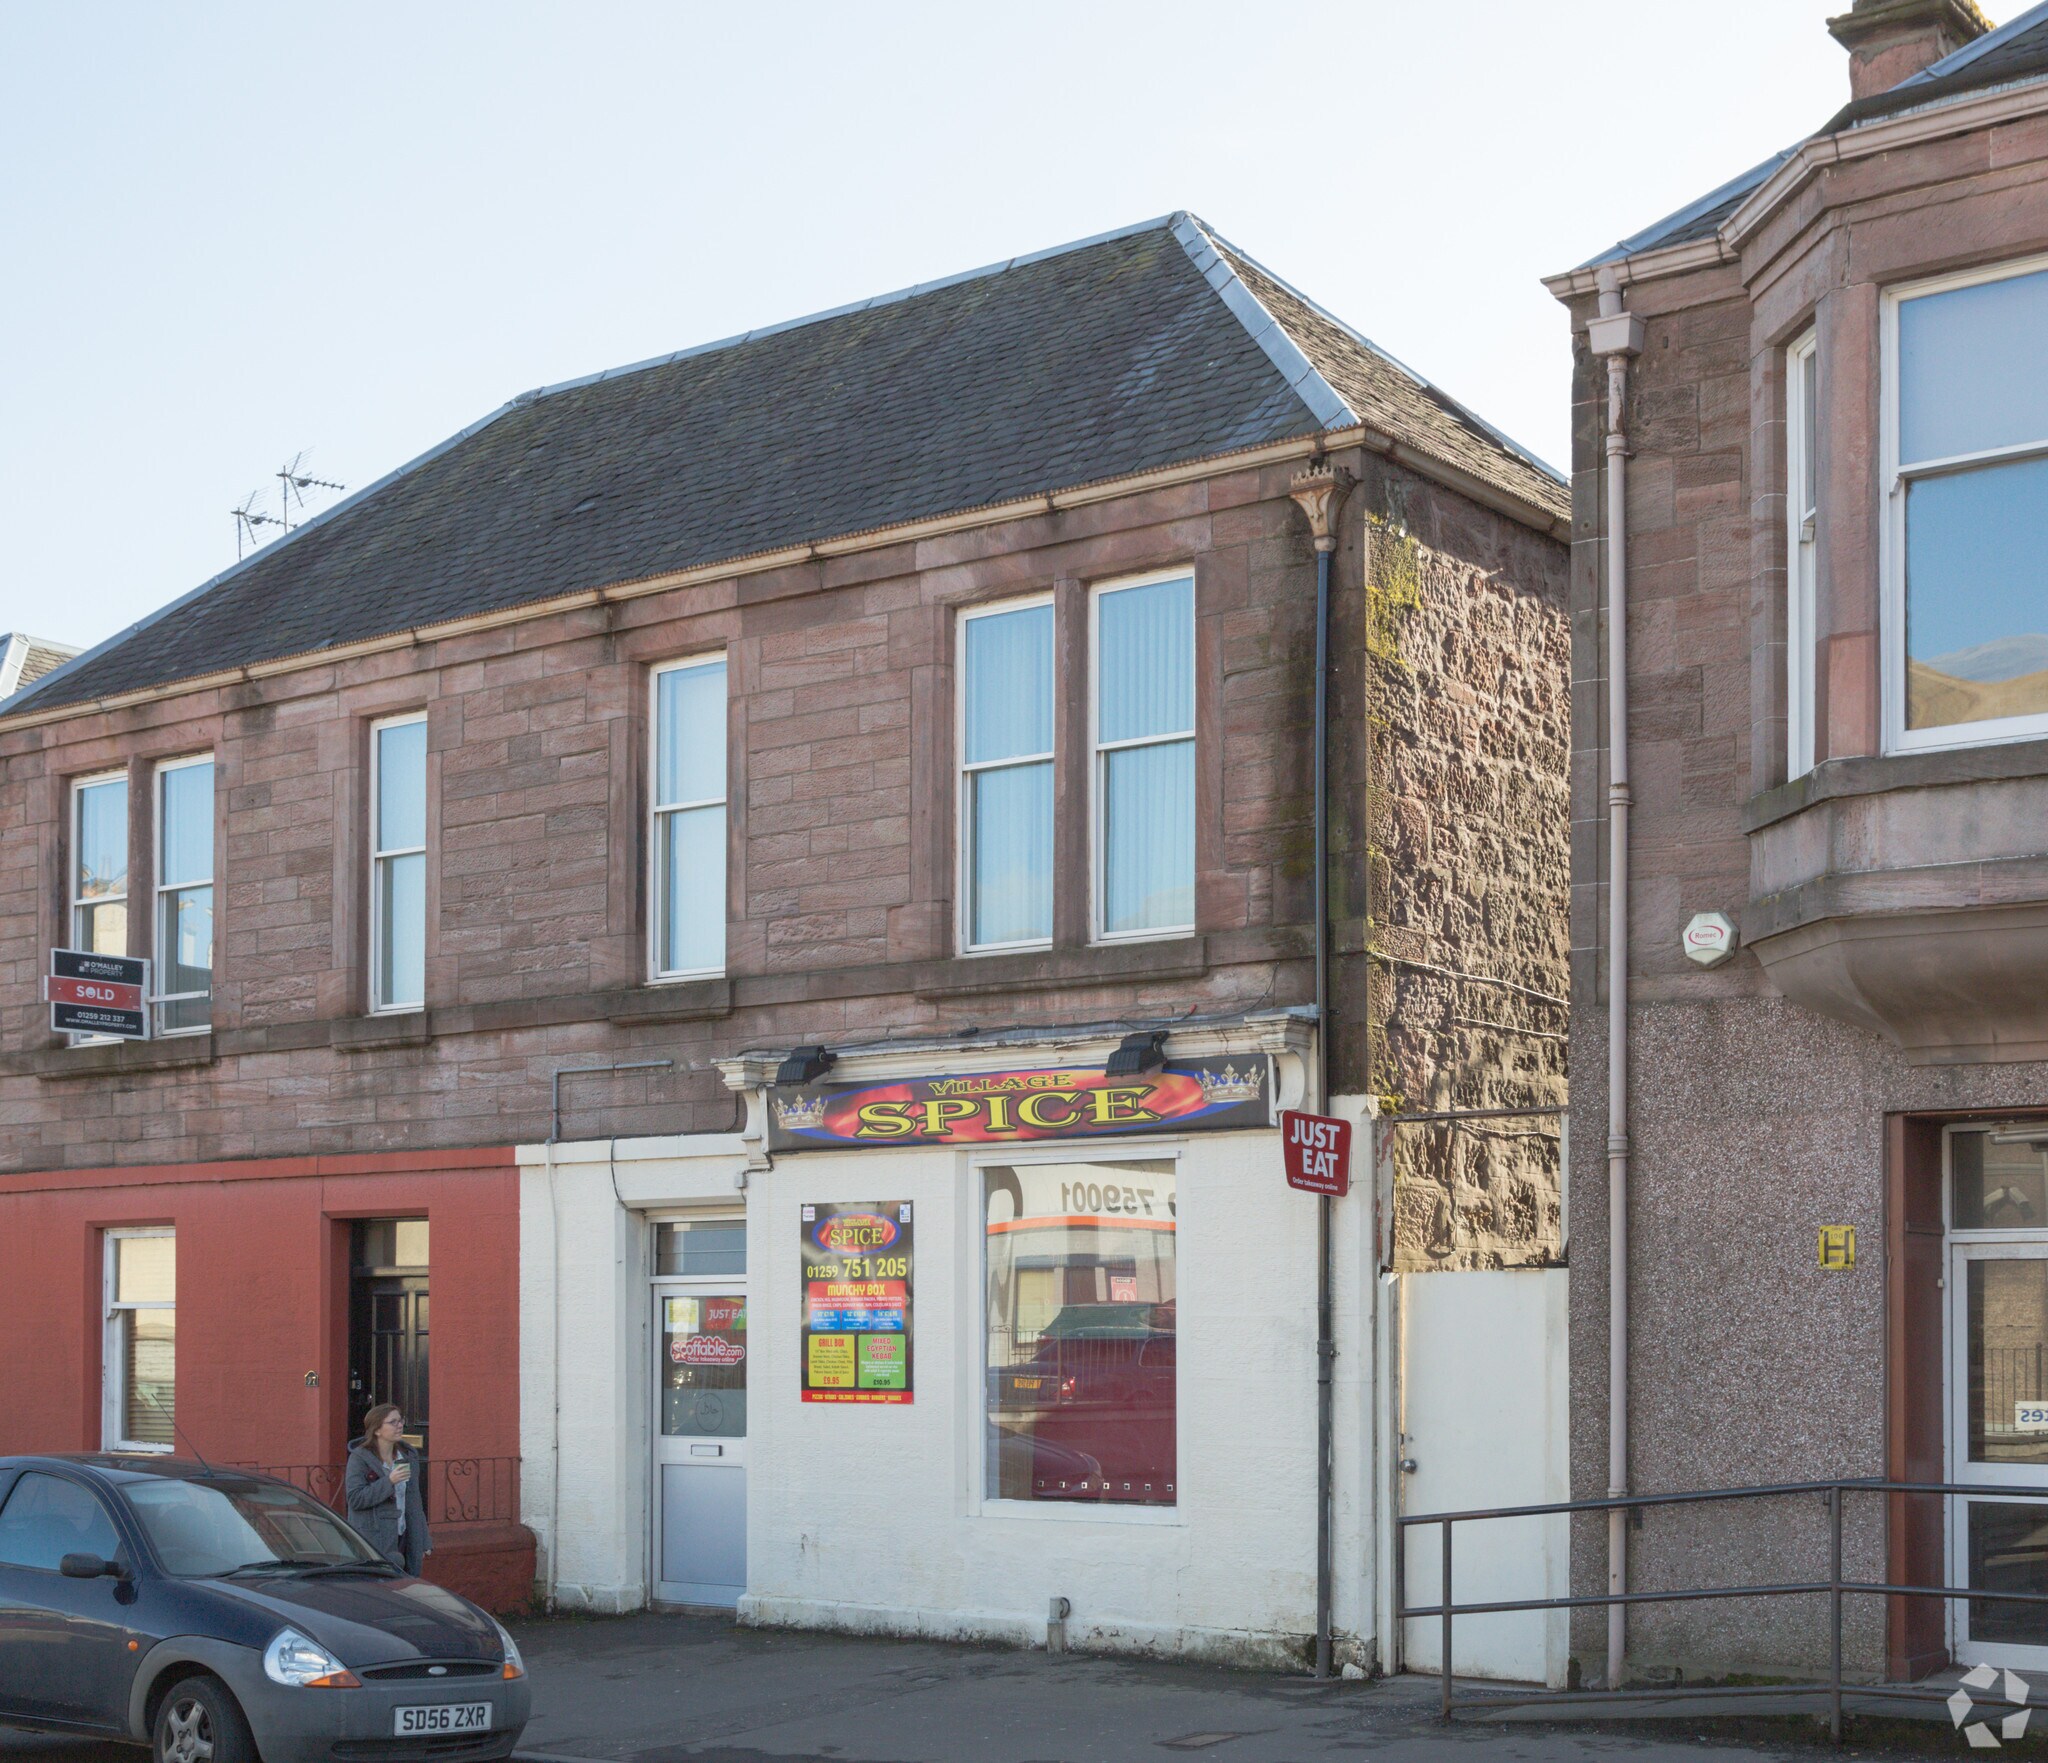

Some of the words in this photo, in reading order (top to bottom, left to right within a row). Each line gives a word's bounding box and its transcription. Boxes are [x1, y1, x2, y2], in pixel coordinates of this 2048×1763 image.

[90, 961, 124, 971] O'MALLEY
[90, 968, 124, 977] PROPERTY
[76, 985, 115, 1001] SOLD
[77, 1011, 98, 1020] 01259
[100, 1013, 111, 1021] 212
[112, 1015, 125, 1023] 337
[929, 1074, 1076, 1095] VILLAGE
[855, 1085, 1162, 1138] SPICE
[1290, 1118, 1340, 1150] JUST
[1302, 1148, 1339, 1178] EAT
[1325, 1183, 1338, 1191] online
[830, 1228, 883, 1245] SPICE
[1824, 1231, 1849, 1264] H
[807, 1265, 839, 1278] 01259
[843, 1258, 871, 1277] 751
[876, 1257, 907, 1277] 205
[827, 1284, 866, 1296] MUNCHY
[867, 1283, 886, 1295] BOX
[709, 1309, 729, 1319] JUST
[403, 1708, 450, 1731] SD56
[454, 1706, 486, 1728] ZXR
